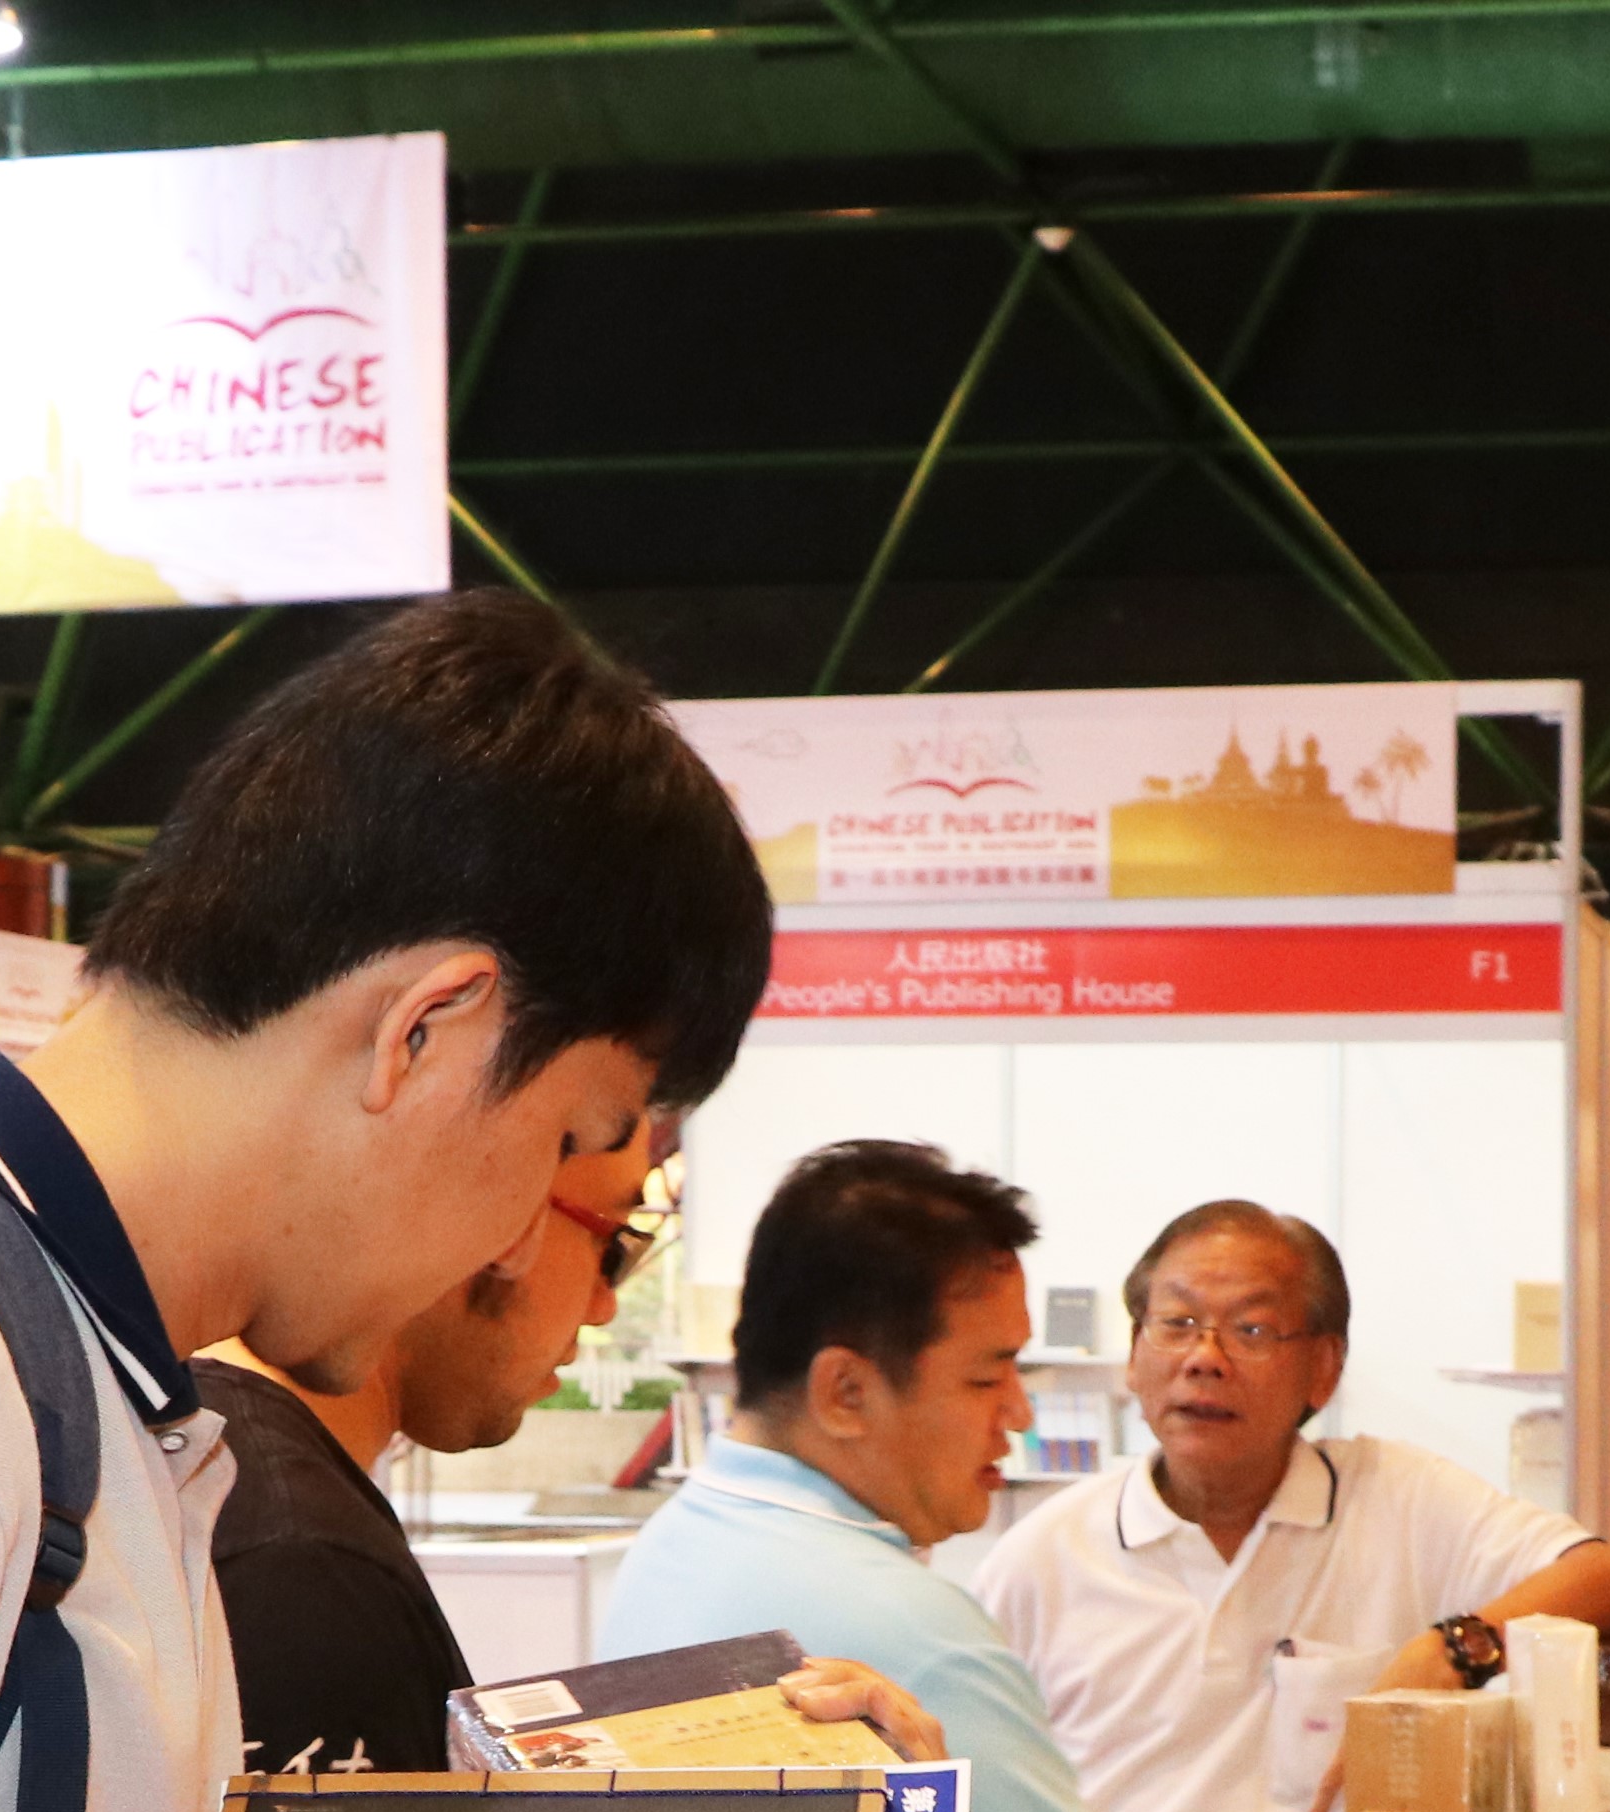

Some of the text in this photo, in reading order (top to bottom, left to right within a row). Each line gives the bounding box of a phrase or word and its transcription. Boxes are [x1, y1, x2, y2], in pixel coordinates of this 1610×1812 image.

[129, 352, 385, 419] CHINESE
[131, 417, 387, 464] PUBLICATION
[885, 939, 1048, 973] 人民出版社
[1470, 949, 1511, 982] F1
[899, 977, 1063, 1013] Publishing
[1072, 976, 1176, 1006] House
